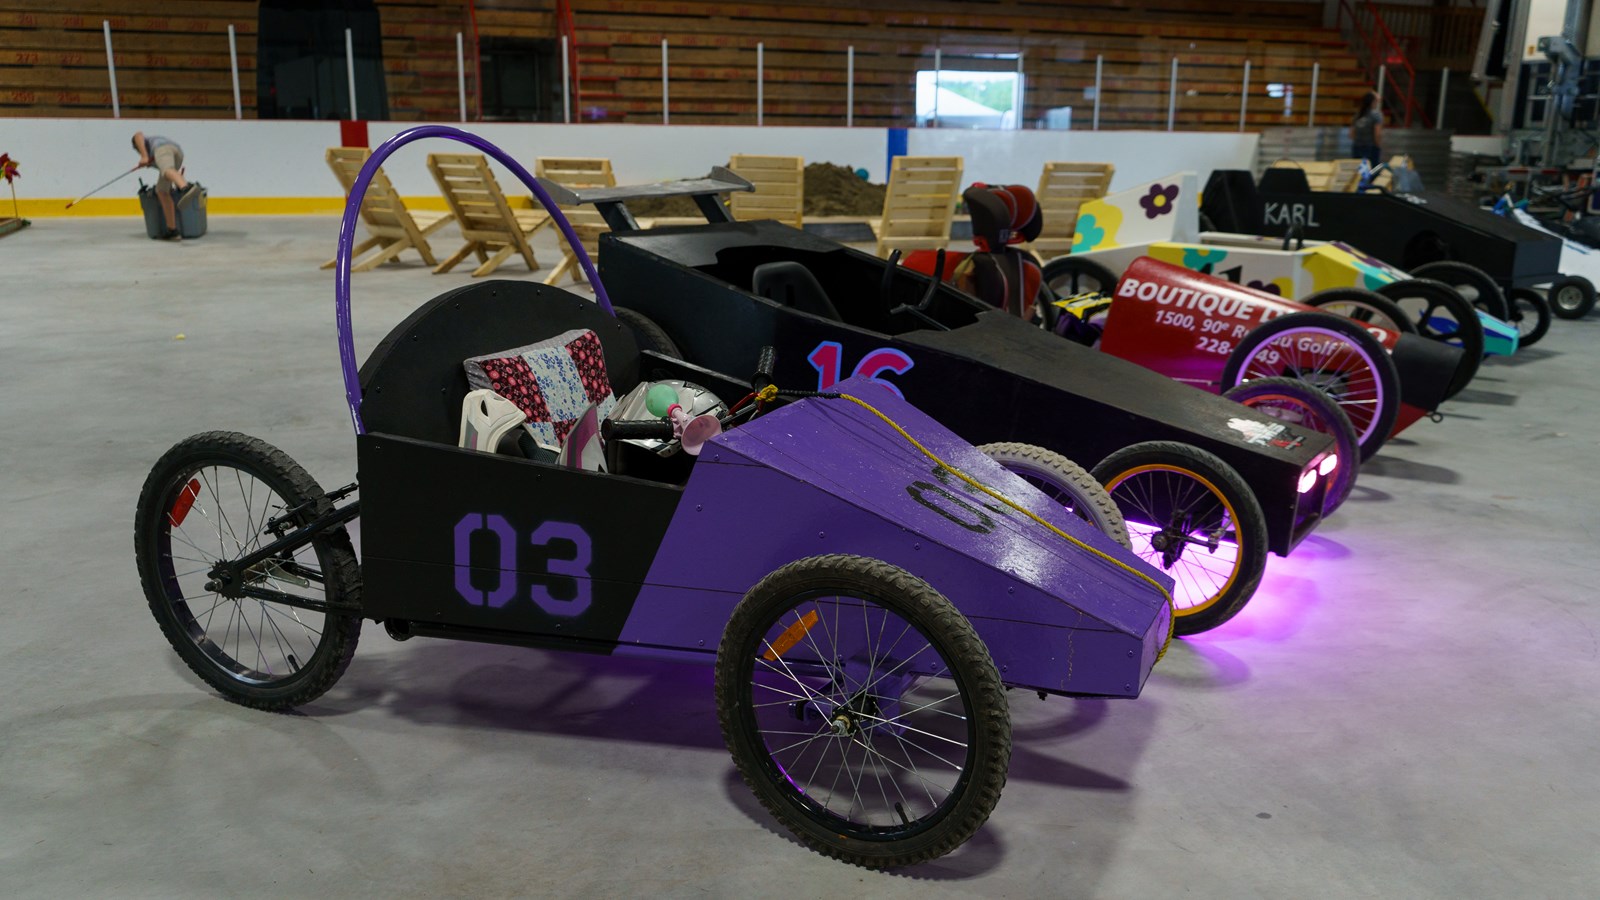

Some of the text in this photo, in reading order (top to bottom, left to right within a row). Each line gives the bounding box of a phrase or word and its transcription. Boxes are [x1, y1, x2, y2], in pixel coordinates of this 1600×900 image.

[1264, 202, 1320, 227] KARL
[1118, 278, 1254, 320] BOUTIQUE
[1155, 309, 1195, 331] 1500,
[1297, 337, 1338, 356] Golf
[453, 512, 592, 617] 03
